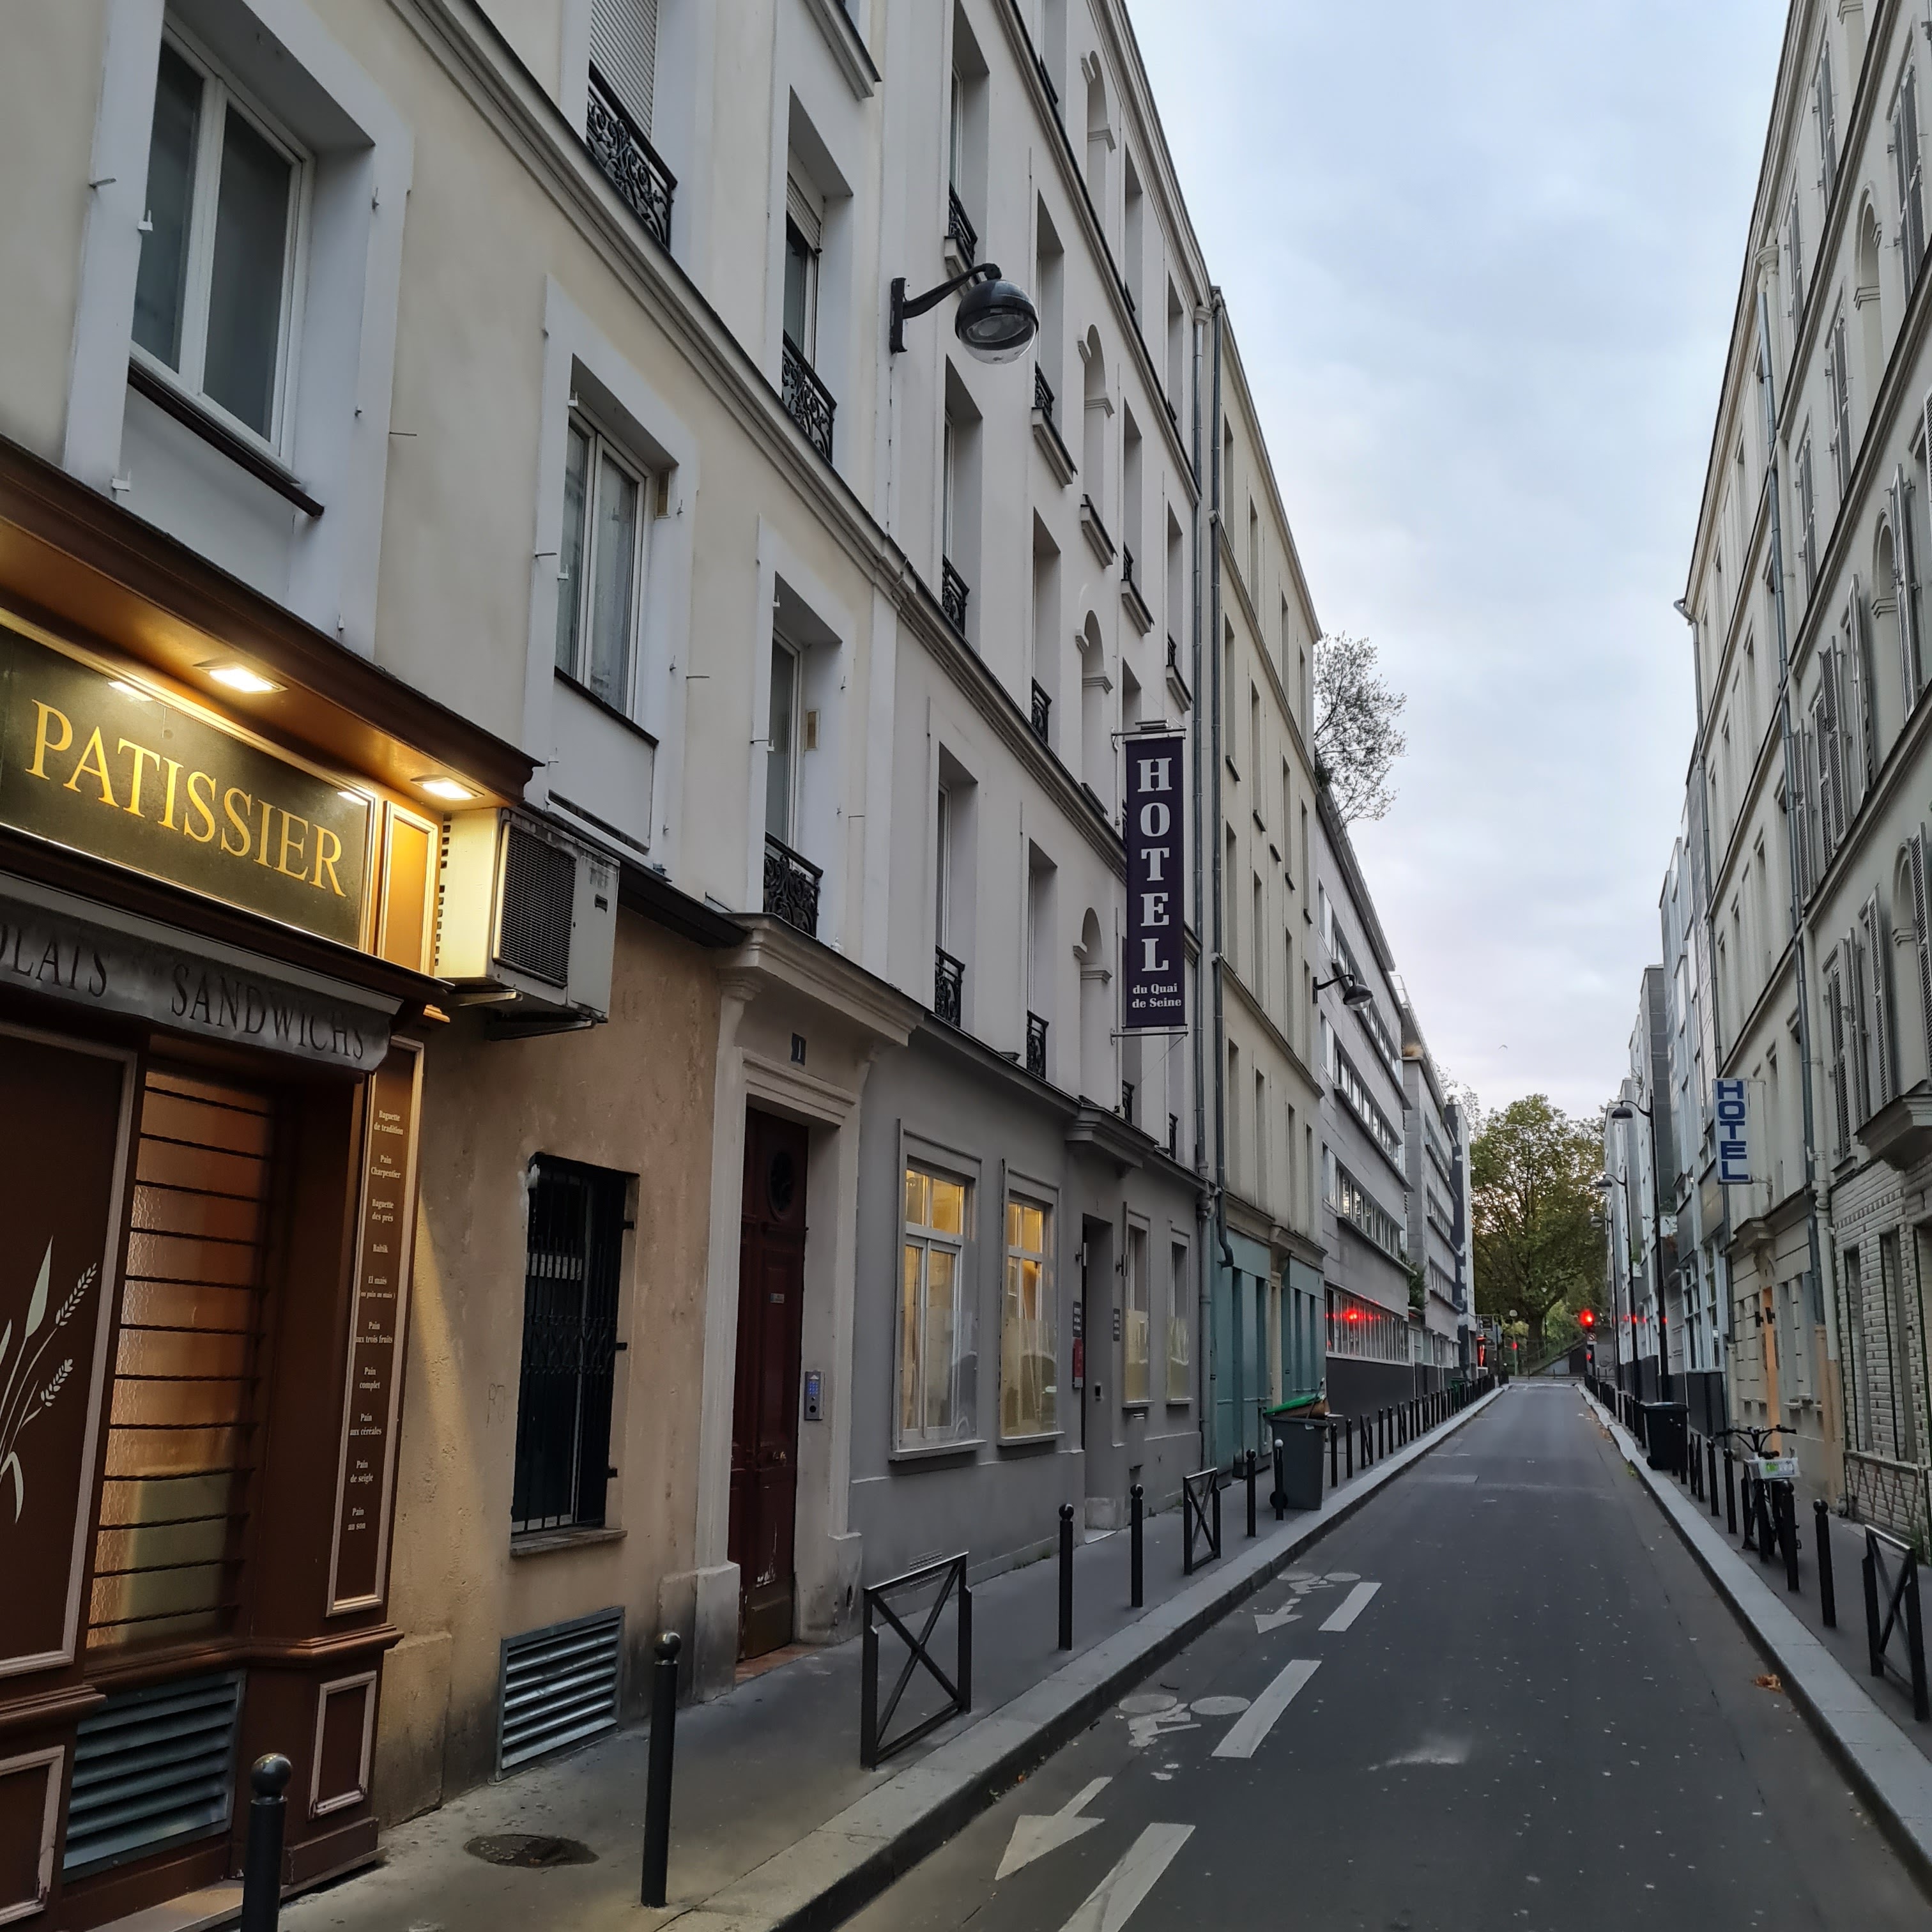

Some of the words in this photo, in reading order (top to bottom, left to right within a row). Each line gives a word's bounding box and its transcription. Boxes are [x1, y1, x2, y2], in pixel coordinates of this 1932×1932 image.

[26, 699, 347, 897] PATISSIER
[1137, 757, 1172, 972] HOTEL
[1133, 985, 1148, 994] du
[1151, 983, 1177, 995] Quai
[1132, 999, 1147, 1008] de
[1149, 997, 1182, 1008] Seine
[171, 963, 364, 1061] SANDWICHS
[379, 1110, 401, 1122] Baguette
[374, 1122, 381, 1131] de
[381, 1124, 403, 1135] tradition
[1717, 1081, 1749, 1180] HOTEL
[380, 1154, 392, 1164] Pain
[371, 1166, 401, 1179] Charpentier
[372, 1199, 394, 1209] Baguette
[372, 1211, 381, 1220] des
[368, 1321, 380, 1330] Pain
[365, 1335, 378, 1344] trois
[378, 1335, 393, 1344] fruits
[364, 1367, 376, 1376] Pain
[359, 1380, 381, 1392] complet
[360, 1413, 372, 1422] Pain
[360, 1426, 382, 1436] céréales
[356, 1459, 369, 1469] Pain
[350, 1474, 358, 1483] de
[358, 1473, 374, 1485] seigle
[352, 1507, 364, 1516] Pain
